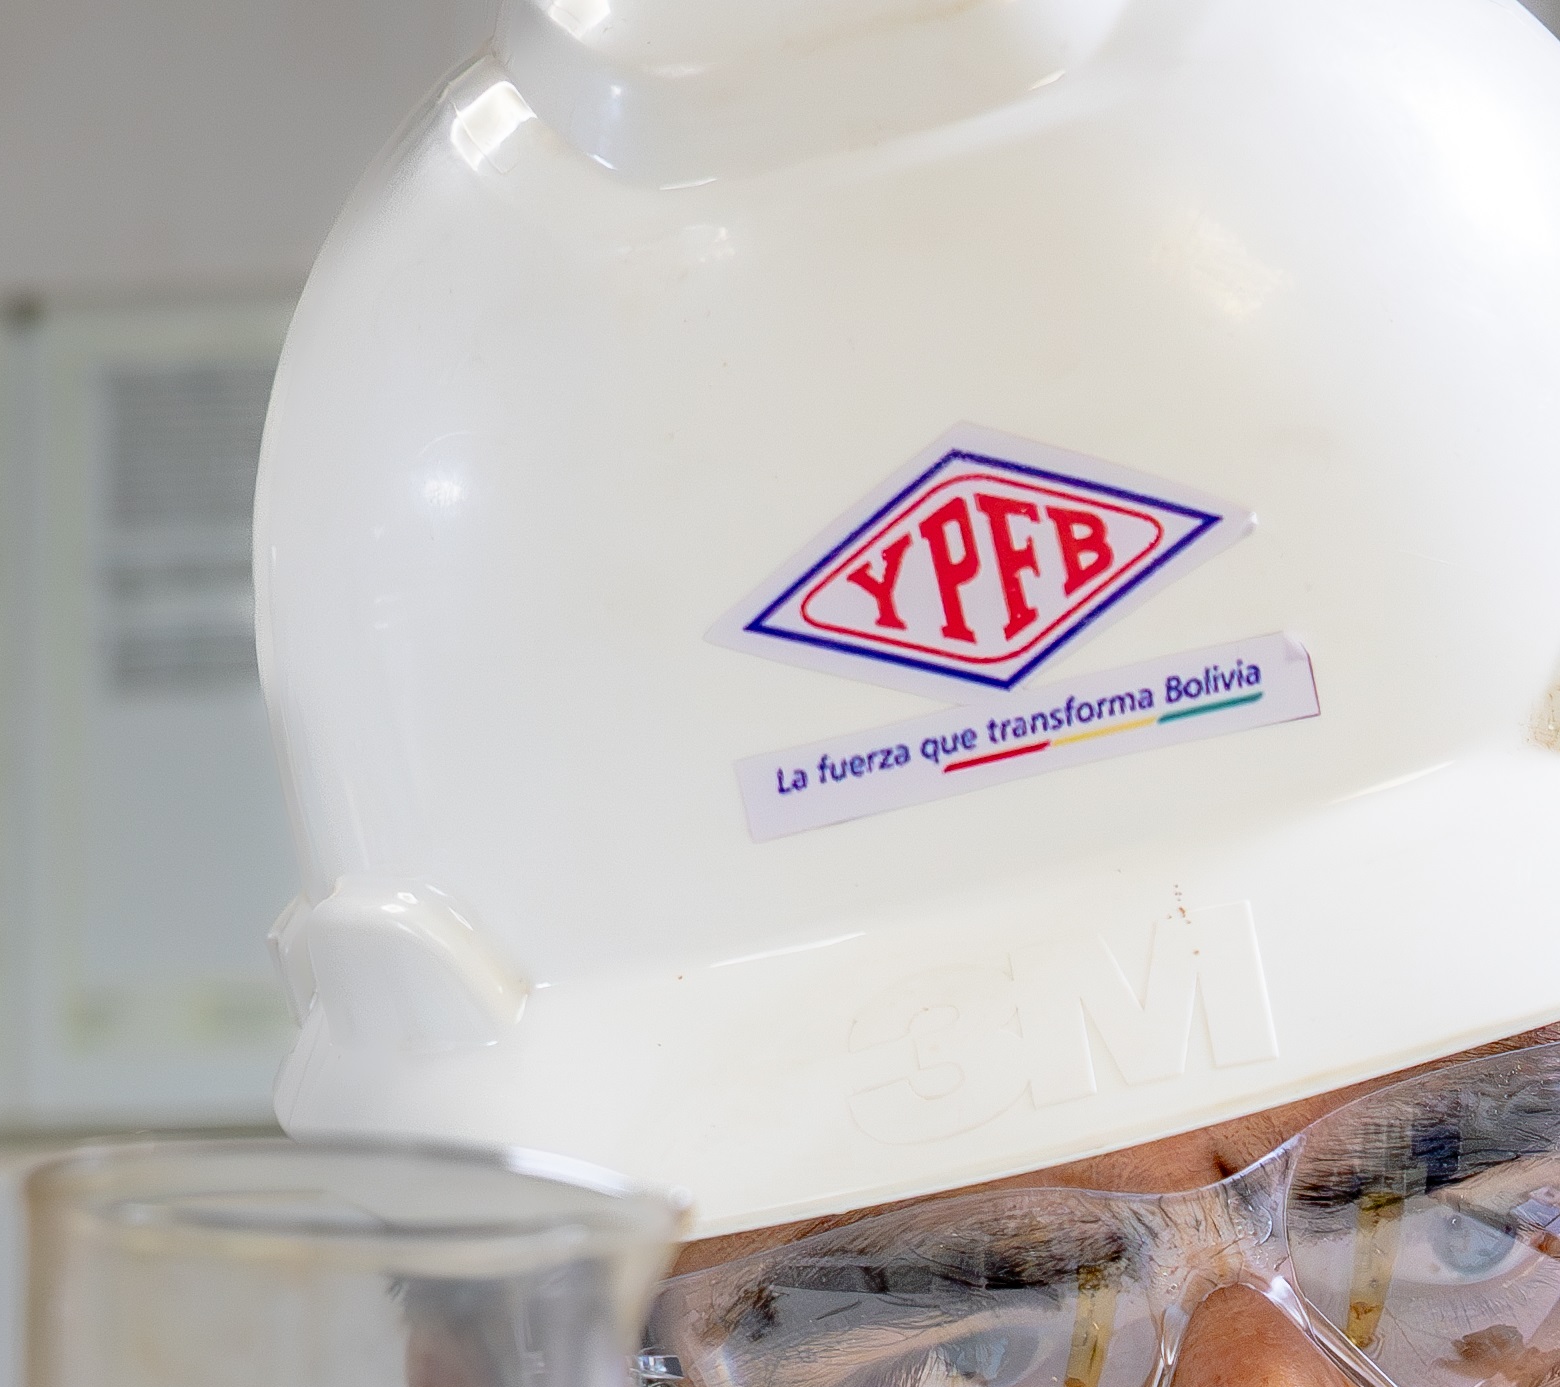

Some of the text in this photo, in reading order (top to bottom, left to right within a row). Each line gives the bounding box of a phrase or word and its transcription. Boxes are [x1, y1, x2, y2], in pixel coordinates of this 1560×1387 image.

[846, 492, 1116, 644] YPFB
[775, 657, 1263, 796] La fuerza que transforma Bolivia
[845, 898, 1281, 1146] 3M
